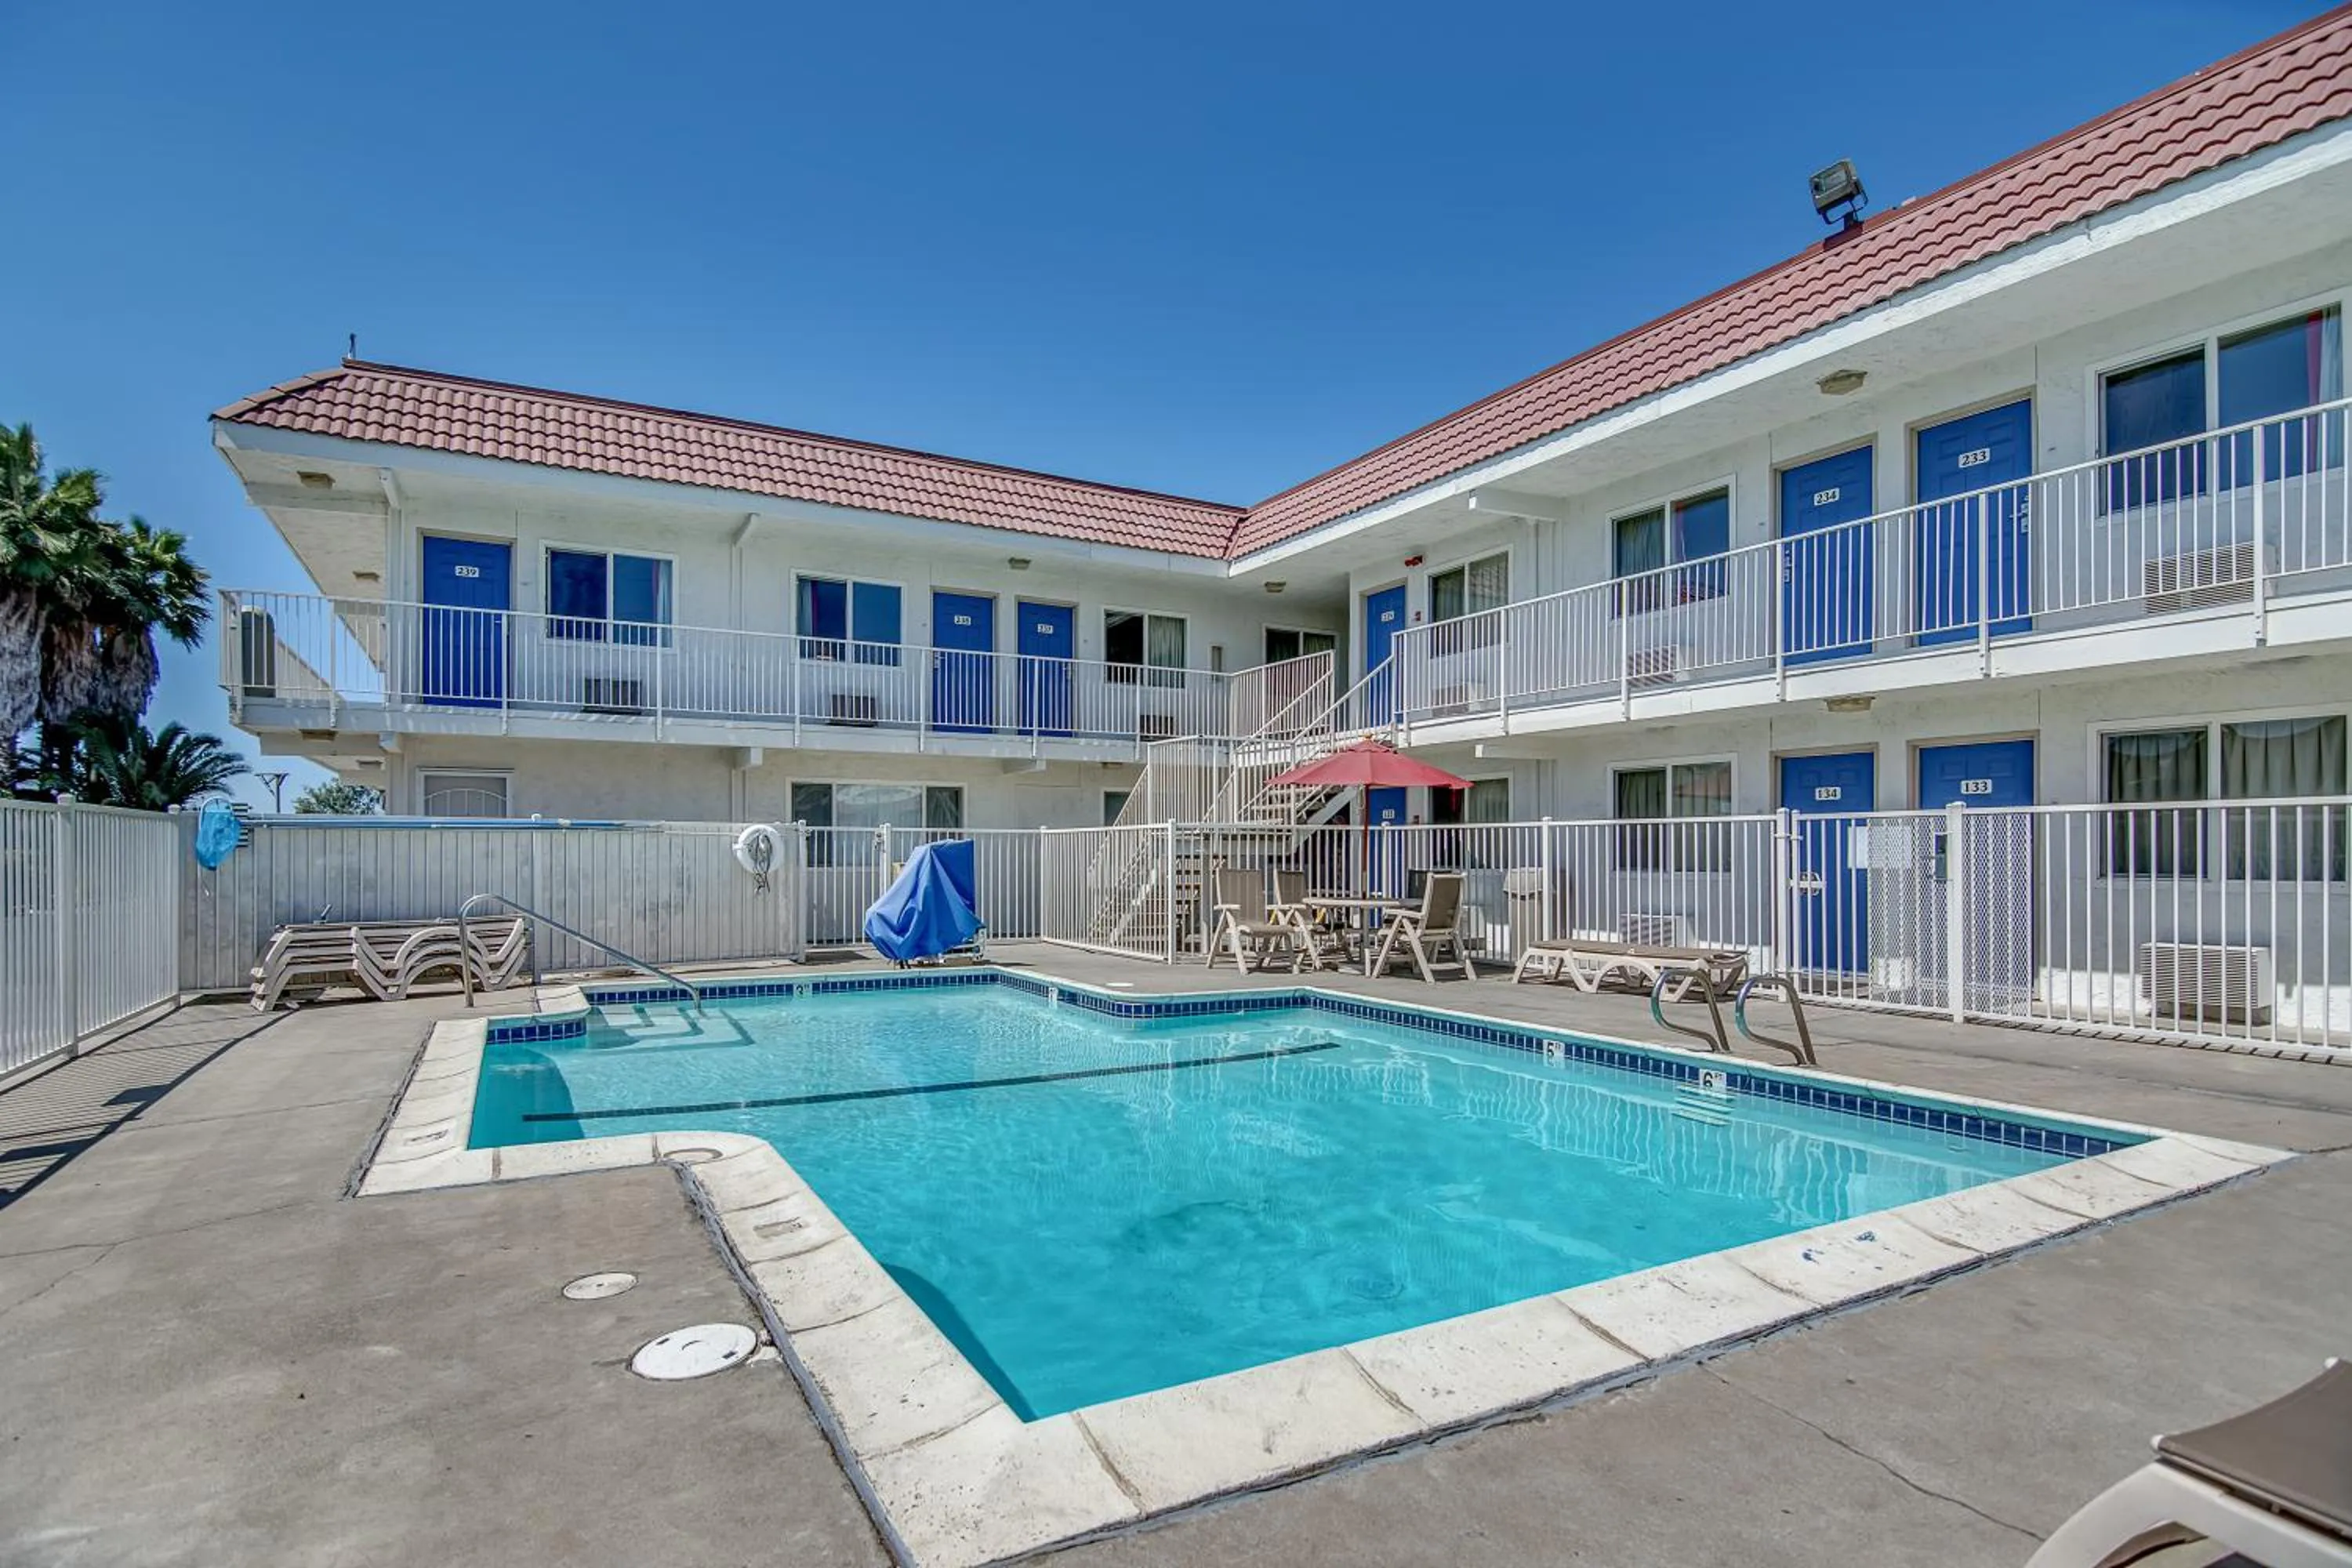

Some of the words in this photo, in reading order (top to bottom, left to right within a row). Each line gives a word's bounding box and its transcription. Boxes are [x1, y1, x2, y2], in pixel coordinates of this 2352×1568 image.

[1962, 451, 1987, 466] 233
[1817, 491, 1837, 503] 234
[457, 567, 477, 576] 239
[1965, 781, 1987, 792] 133
[1818, 788, 1837, 798] 134
[1548, 1042, 1555, 1058] 5
[1703, 1072, 1713, 1088] 6
